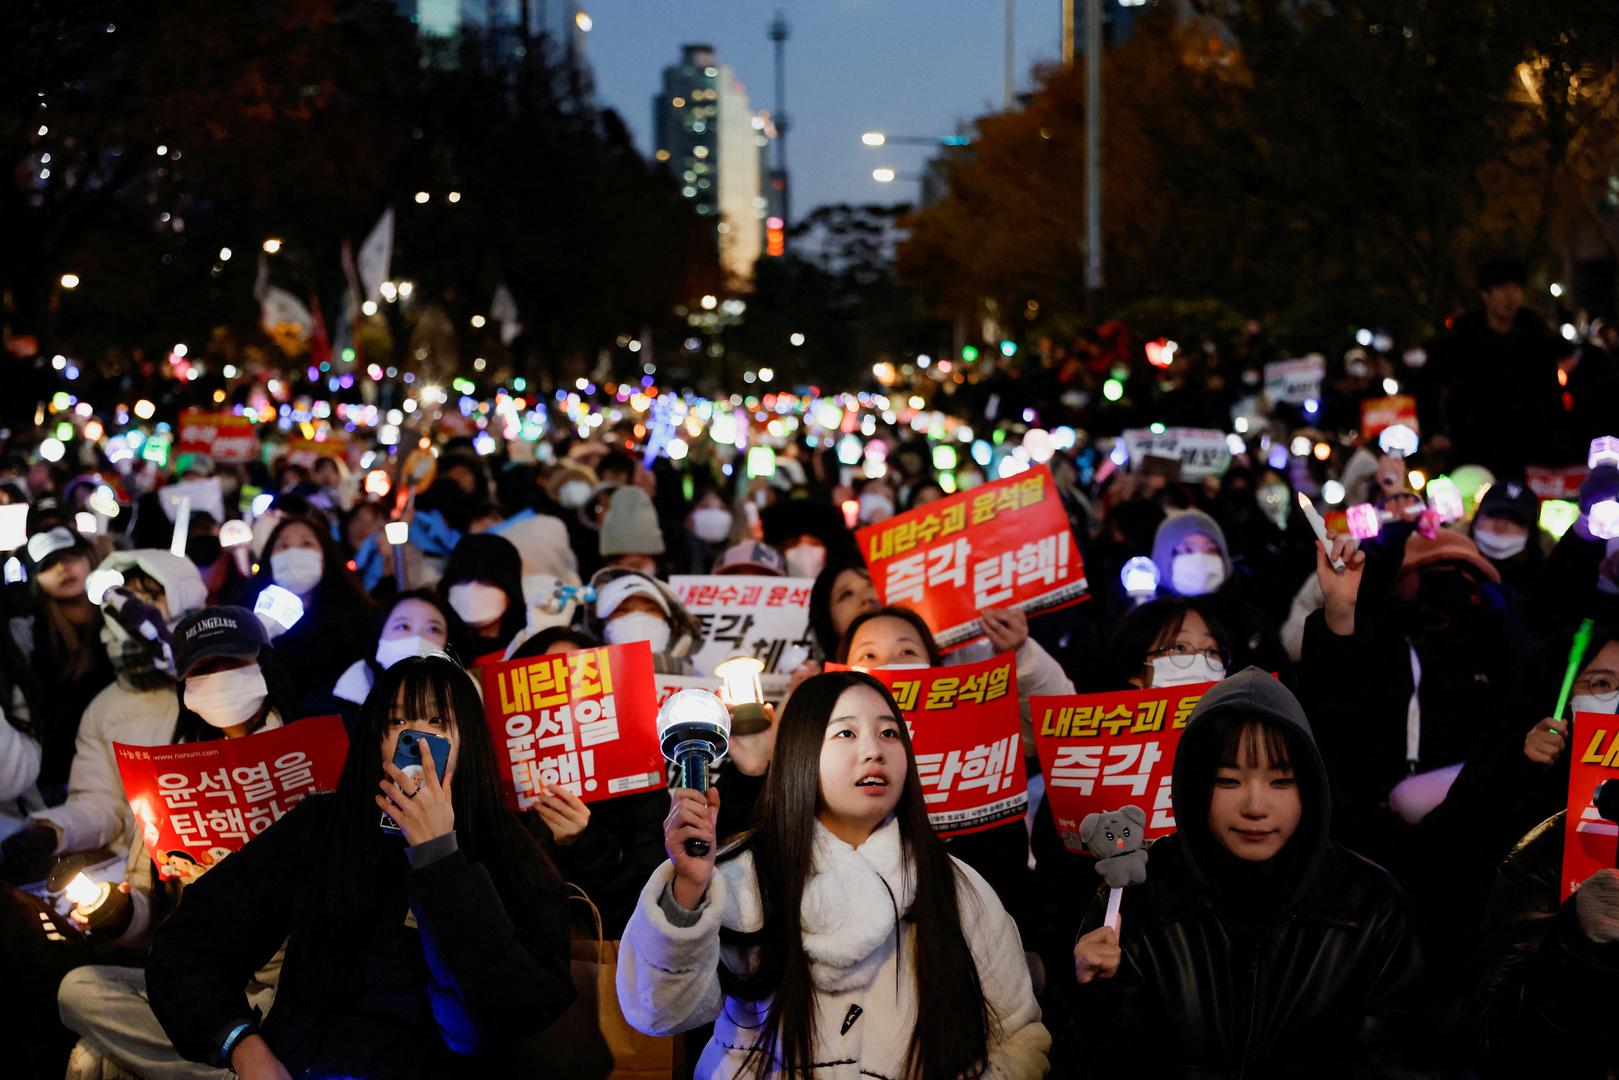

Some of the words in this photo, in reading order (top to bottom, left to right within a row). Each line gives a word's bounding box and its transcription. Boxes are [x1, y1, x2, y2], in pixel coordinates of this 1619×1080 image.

[870, 502, 967, 562] 내란수괴
[972, 475, 1046, 525] 윤석열
[765, 585, 812, 608] 윤석
[885, 537, 972, 606] 즉각
[974, 531, 1070, 610] 탄핵!
[498, 648, 613, 715] 내란죄
[924, 664, 1010, 710] 윤석열
[505, 695, 620, 763] 윤석열
[1040, 699, 1168, 737] 내란수괴
[153, 749, 219, 761] www.nanum.com
[158, 751, 316, 810] 윤석열을
[511, 749, 598, 809] 탄핵!
[915, 733, 1020, 804] 탄핵!
[1051, 741, 1162, 796] 즉각
